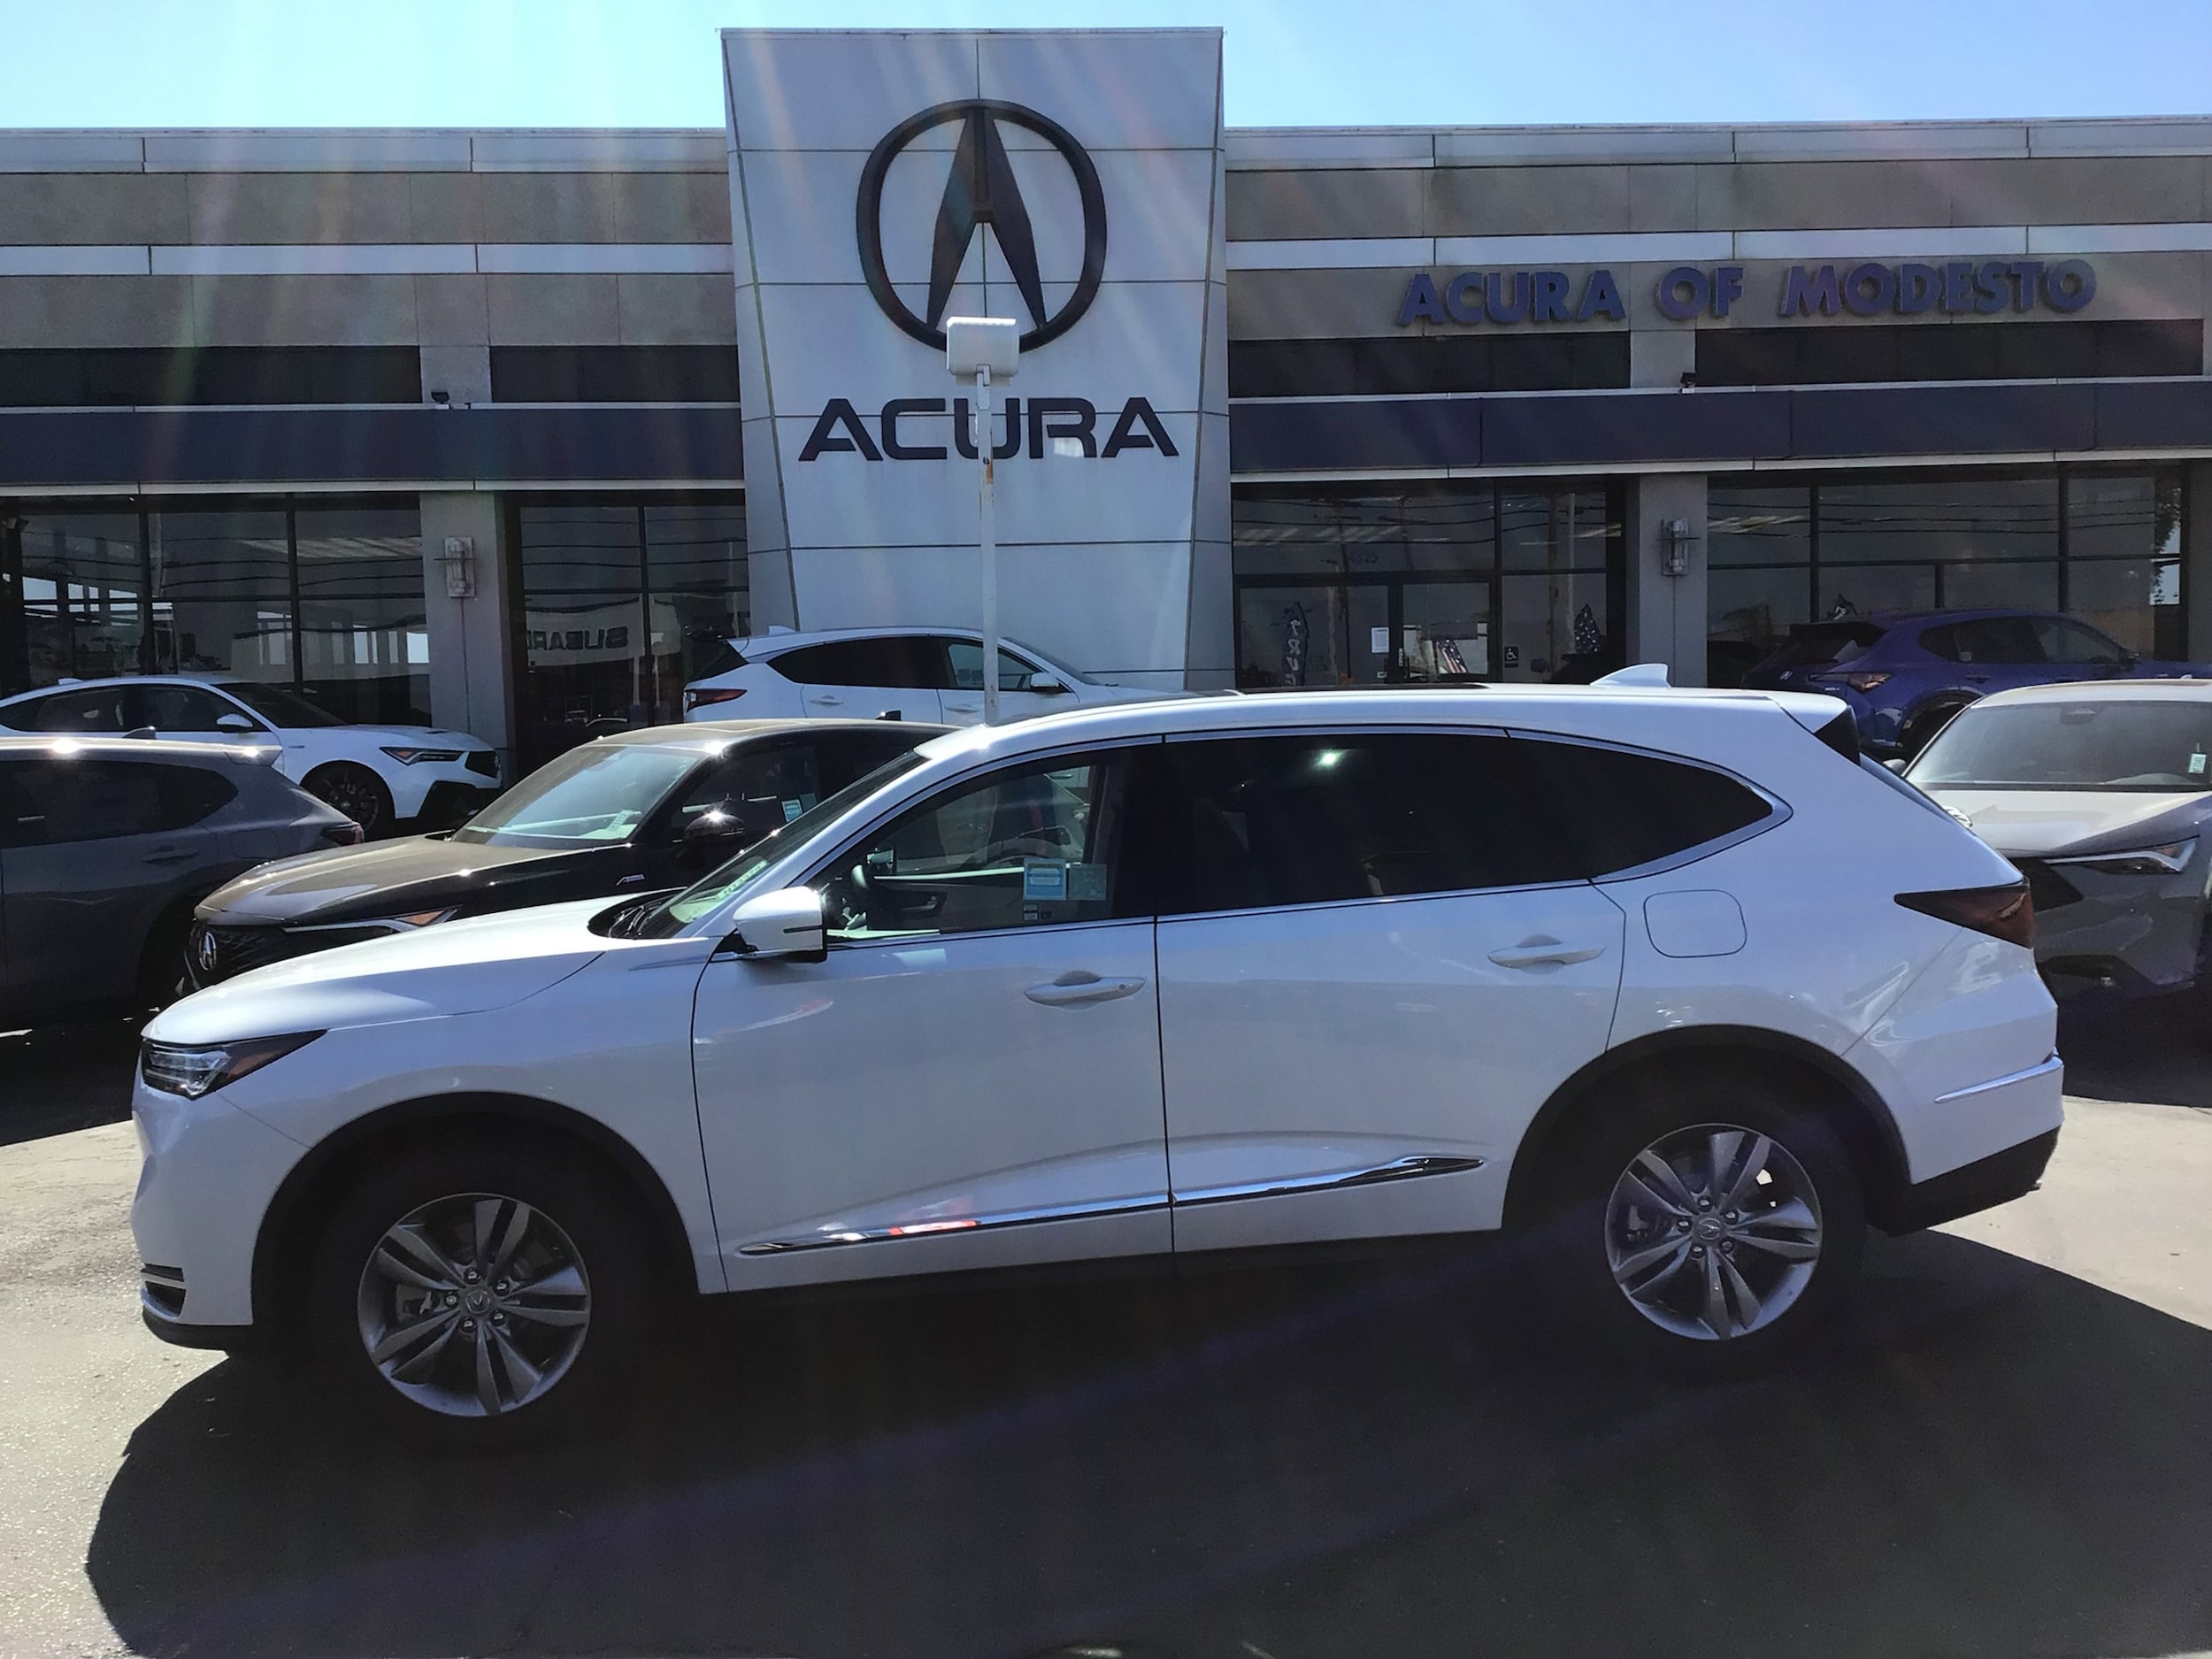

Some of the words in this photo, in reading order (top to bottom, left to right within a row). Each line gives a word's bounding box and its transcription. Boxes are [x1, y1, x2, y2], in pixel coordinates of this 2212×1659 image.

[1397, 270, 1625, 326] ACURA
[1655, 266, 1743, 321] OF
[1780, 258, 2097, 317] MODESTO
[798, 396, 1179, 461] ACURA
